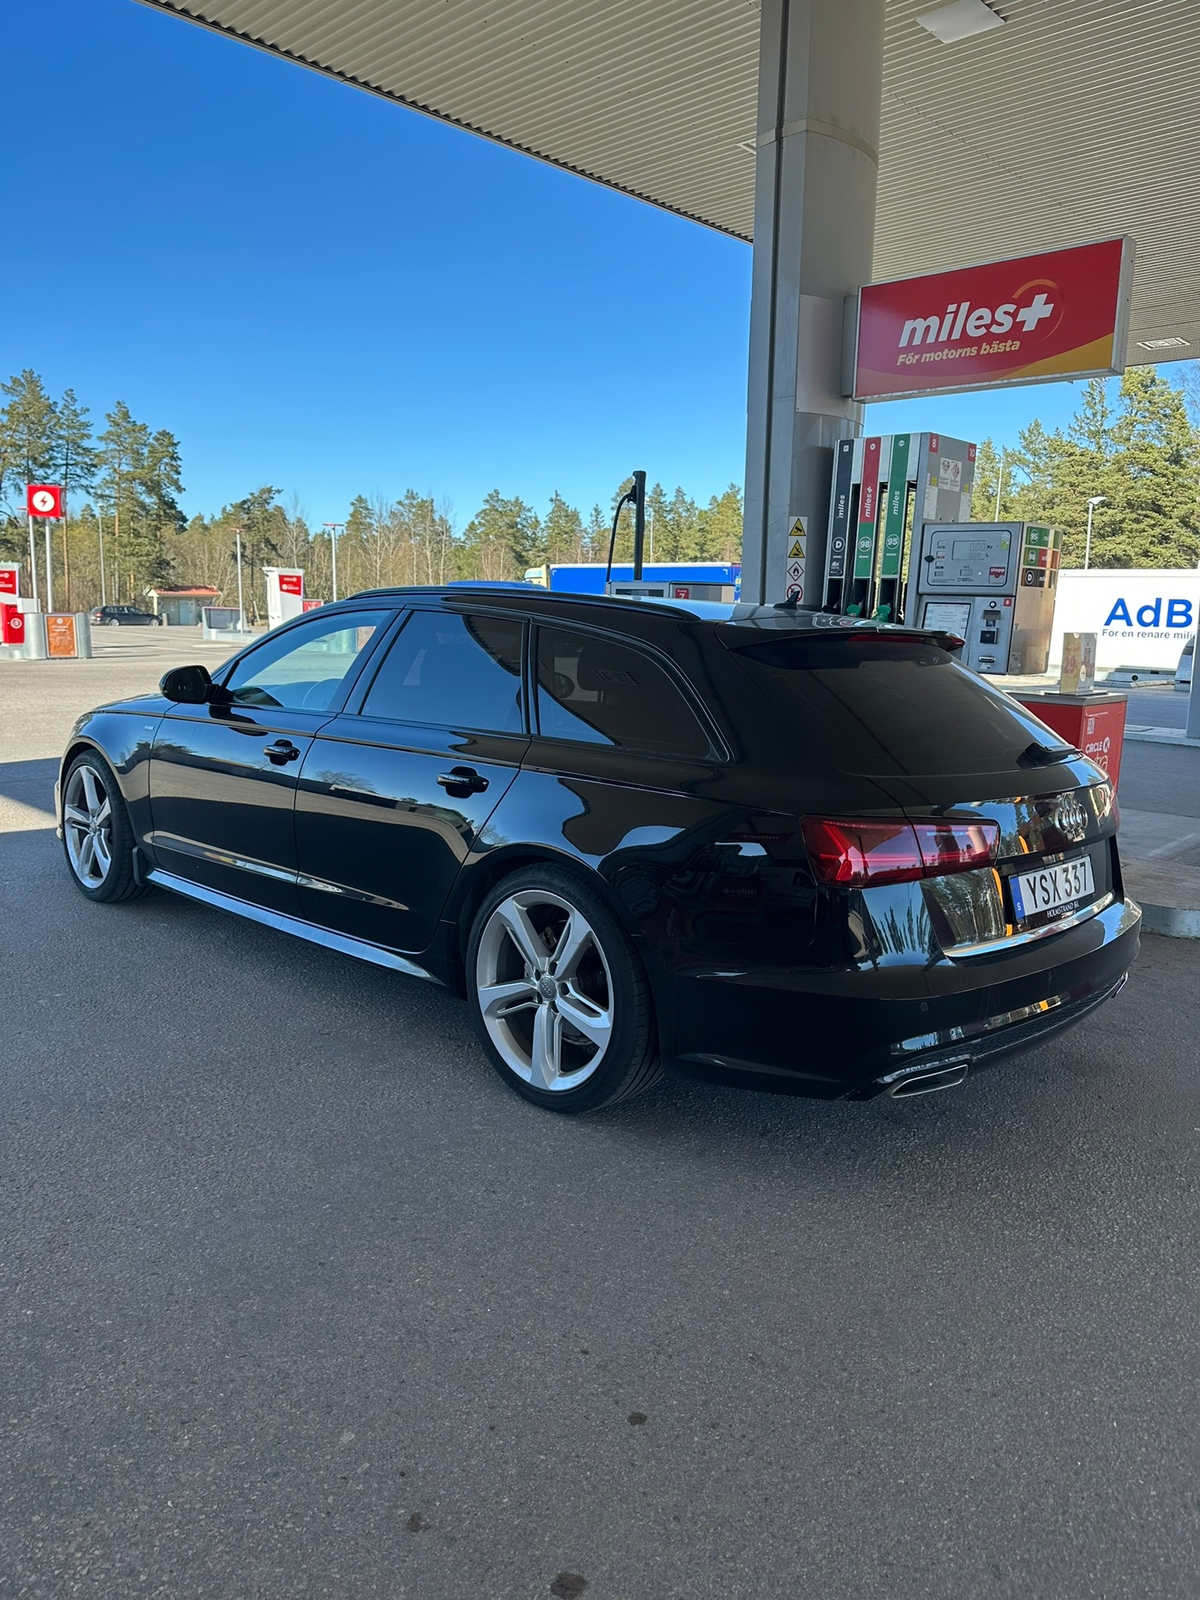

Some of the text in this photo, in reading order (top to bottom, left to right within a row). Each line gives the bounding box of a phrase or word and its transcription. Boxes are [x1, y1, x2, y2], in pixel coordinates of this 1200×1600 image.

[898, 293, 1054, 348] miles+
[897, 338, 1021, 366] För motorns bästa
[932, 438, 937, 448] 8
[969, 448, 976, 458] 10
[837, 494, 846, 519] miles
[893, 490, 901, 516] miles
[835, 540, 842, 549] D
[860, 540, 871, 549] 98
[887, 537, 899, 546] 95
[1102, 628, 1119, 637] För
[1122, 630, 1134, 638] en
[1137, 630, 1170, 639] renare
[1085, 741, 1103, 754] CIRCLE
[1026, 861, 1088, 909] YSX 337
[1016, 902, 1022, 912] S
